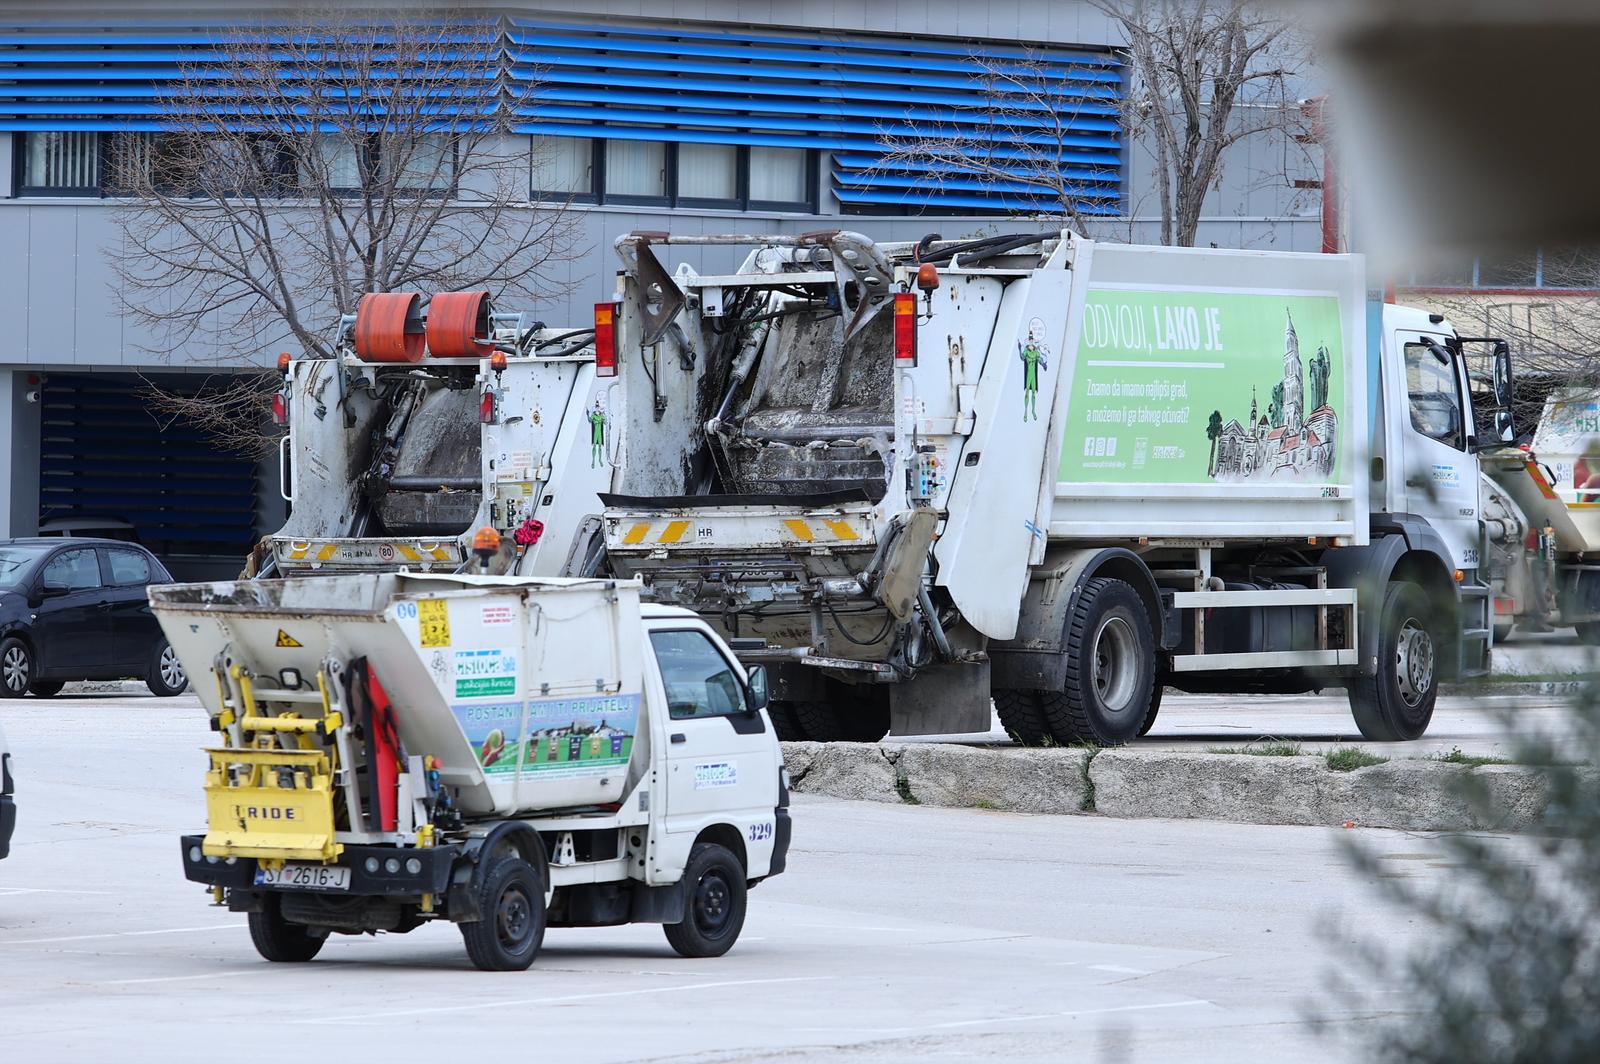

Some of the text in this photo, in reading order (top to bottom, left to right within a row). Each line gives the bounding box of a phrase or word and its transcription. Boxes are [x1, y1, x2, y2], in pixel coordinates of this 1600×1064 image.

[1083, 303, 1224, 355] ODVOJI, LAKO JE
[1087, 379, 1111, 397] Znamo
[1112, 379, 1120, 397] da
[1121, 379, 1145, 397] imamo
[1087, 409, 1092, 422] a
[1128, 410, 1137, 427] ga
[698, 528, 713, 537] HR
[571, 697, 630, 715] PRIJATELJ
[749, 823, 772, 842] 329
